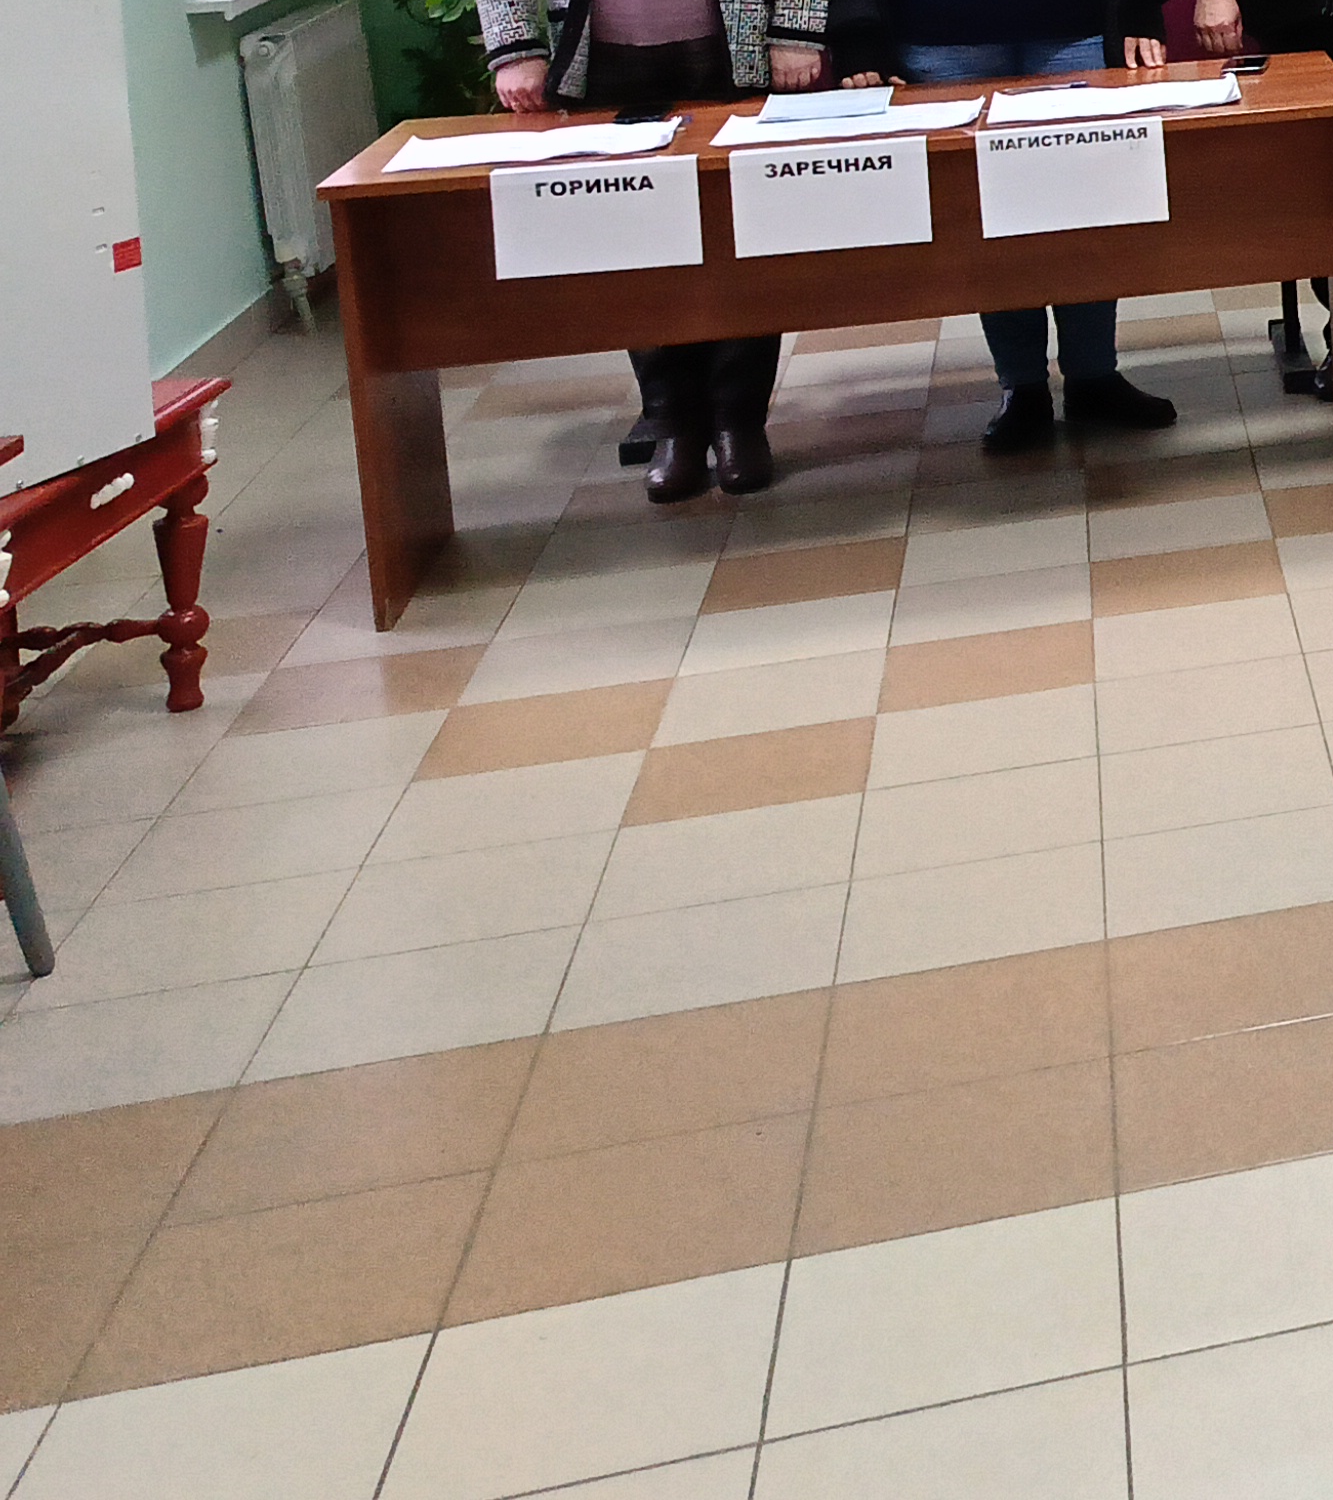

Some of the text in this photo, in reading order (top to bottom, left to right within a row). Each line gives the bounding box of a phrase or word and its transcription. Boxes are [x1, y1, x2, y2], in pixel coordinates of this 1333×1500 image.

[988, 127, 1149, 153] МАГИСТРАЛЬНАЯ
[763, 154, 895, 180] ЗАРЕЧНАЯ
[533, 174, 656, 199] ГОРИНКА
